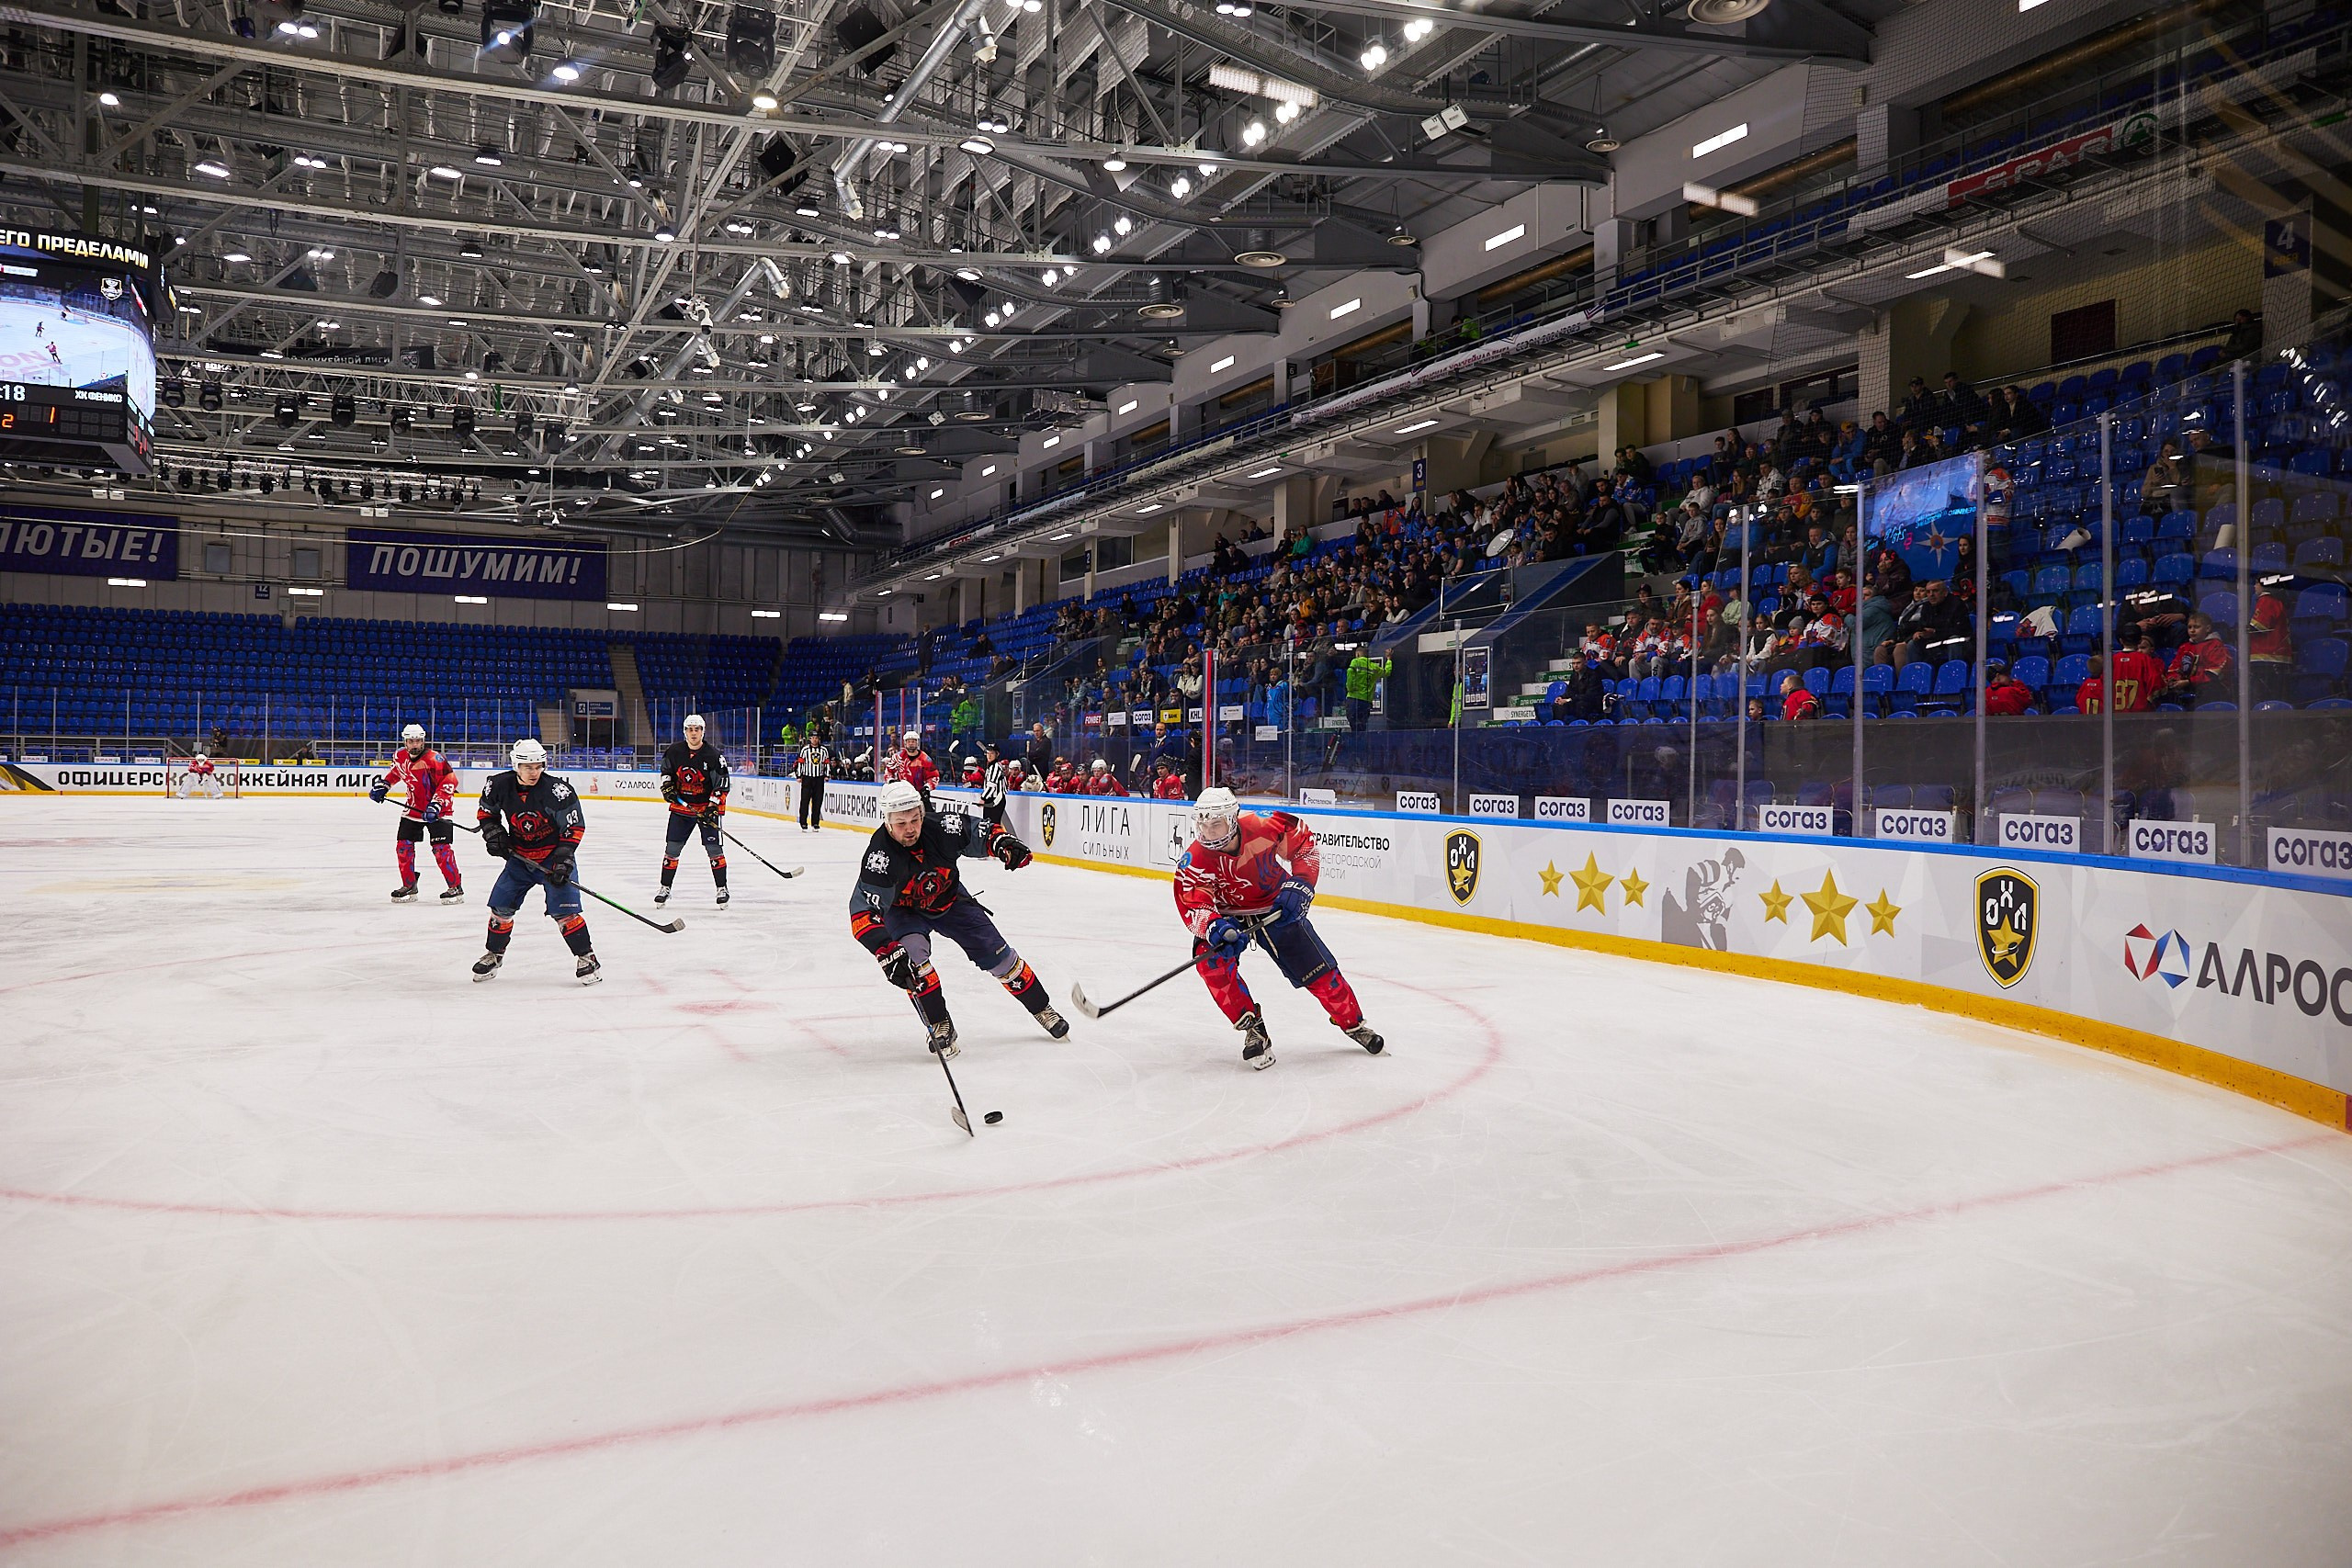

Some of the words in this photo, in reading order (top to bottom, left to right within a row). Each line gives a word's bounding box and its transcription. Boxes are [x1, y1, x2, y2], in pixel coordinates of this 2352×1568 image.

[2276, 220, 2296, 250] 4
[38, 234, 149, 270] ПРЕДЕЛАМИ
[365, 356, 391, 365] ЛИГИ
[1289, 367, 1295, 375] 6
[2, 413, 14, 428] 2
[49, 406, 56, 423] 1
[1417, 463, 1423, 479] 3
[368, 546, 582, 585] ПОШУМИМ!
[1086, 552, 1091, 564] 2
[2115, 679, 2139, 711] 87
[1510, 710, 1536, 718] SYNERGETIC
[58, 771, 189, 786] ОФИЦЕРСК
[217, 770, 328, 787] ХОККЕЙНАЯ
[719, 777, 729, 787] 11
[824, 792, 877, 818] ОФИЦЕРСКАЯ
[1307, 796, 1332, 806] Ростелеком
[565, 809, 579, 827] 93
[1080, 805, 1131, 837] ЛИГА
[1082, 840, 1129, 861] СИЛЬНЫХ
[1320, 852, 1382, 869] ЖЕГОРОДСКОЙ
[1320, 866, 1346, 880] ЛАСТИ
[1985, 879, 2027, 931] ОХЛ
[1302, 962, 1326, 982] EASTON
